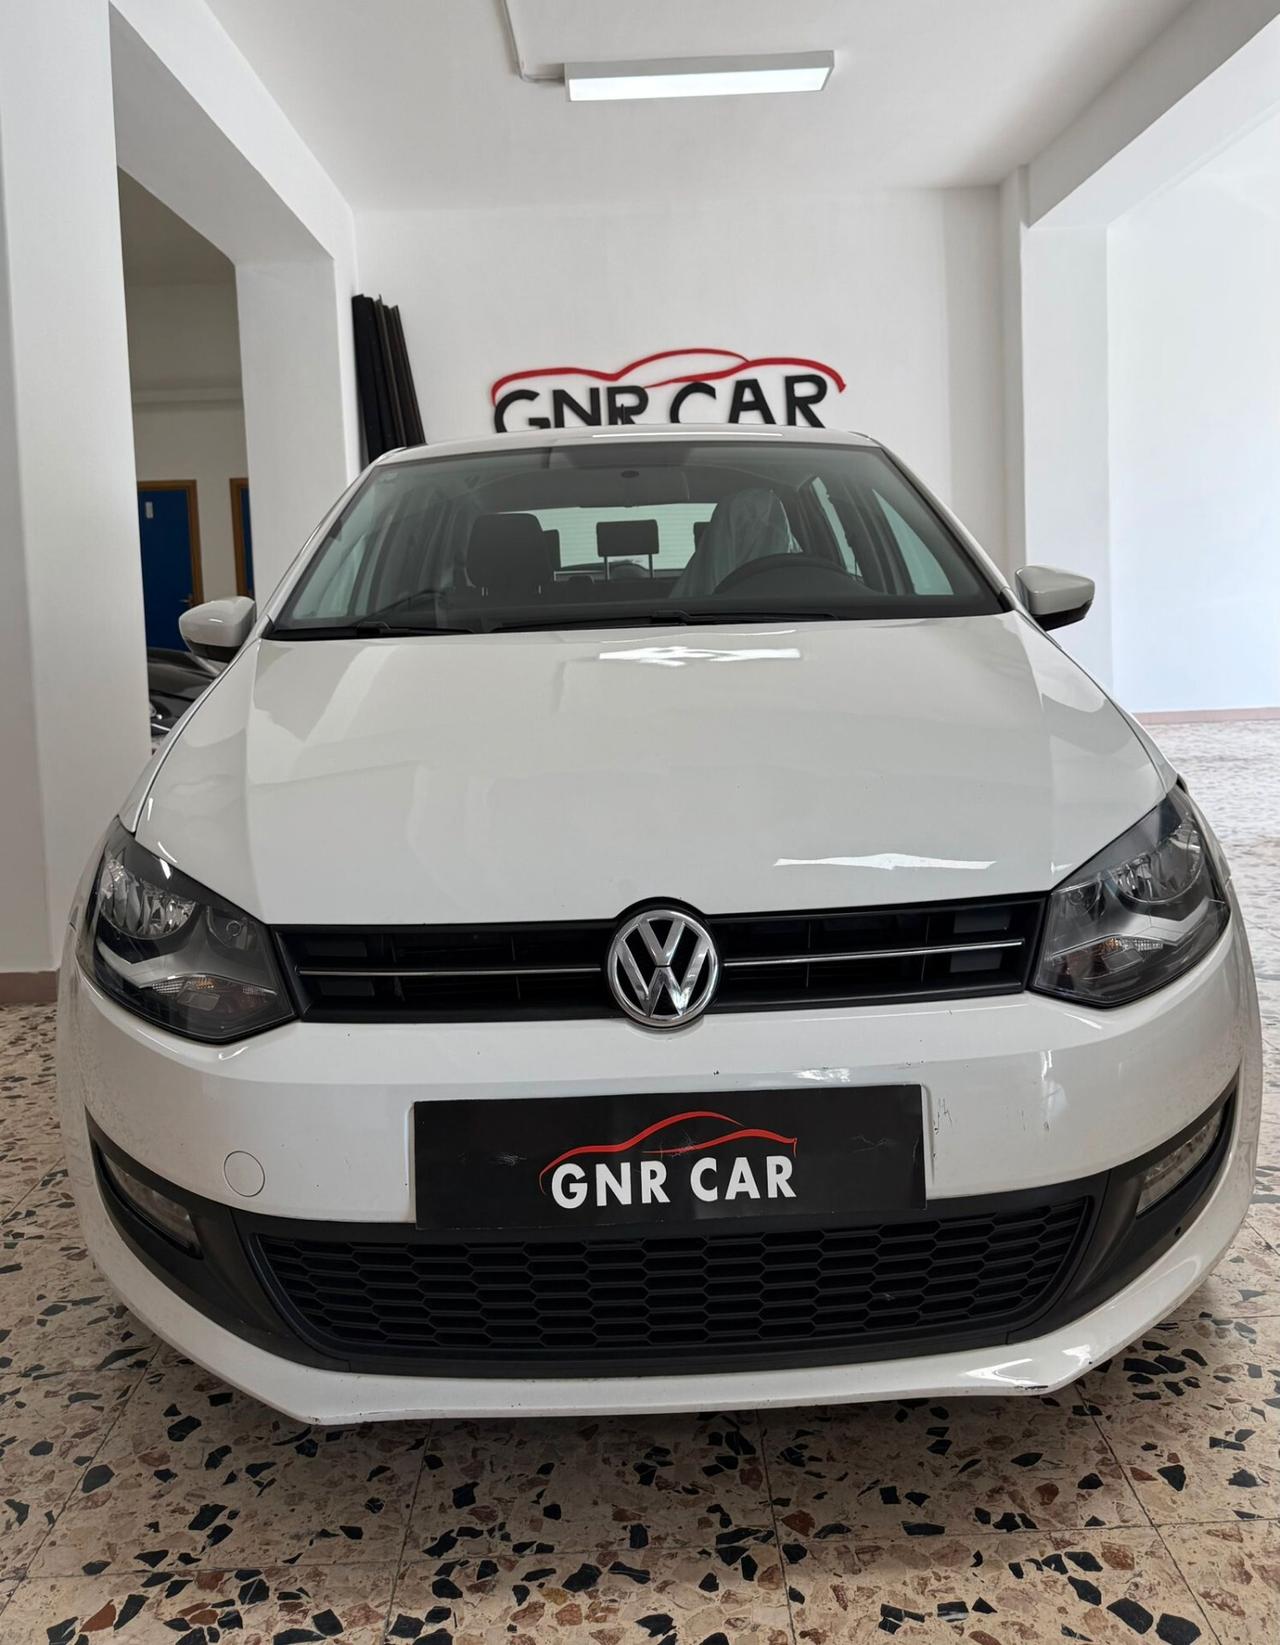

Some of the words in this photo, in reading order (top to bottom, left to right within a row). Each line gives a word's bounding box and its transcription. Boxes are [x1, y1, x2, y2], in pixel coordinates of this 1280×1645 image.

[494, 385, 648, 433] GNR
[670, 374, 826, 429] CAR
[611, 912, 715, 1023] VW
[551, 1160, 671, 1210] GNR
[690, 1155, 797, 1202] CAR
